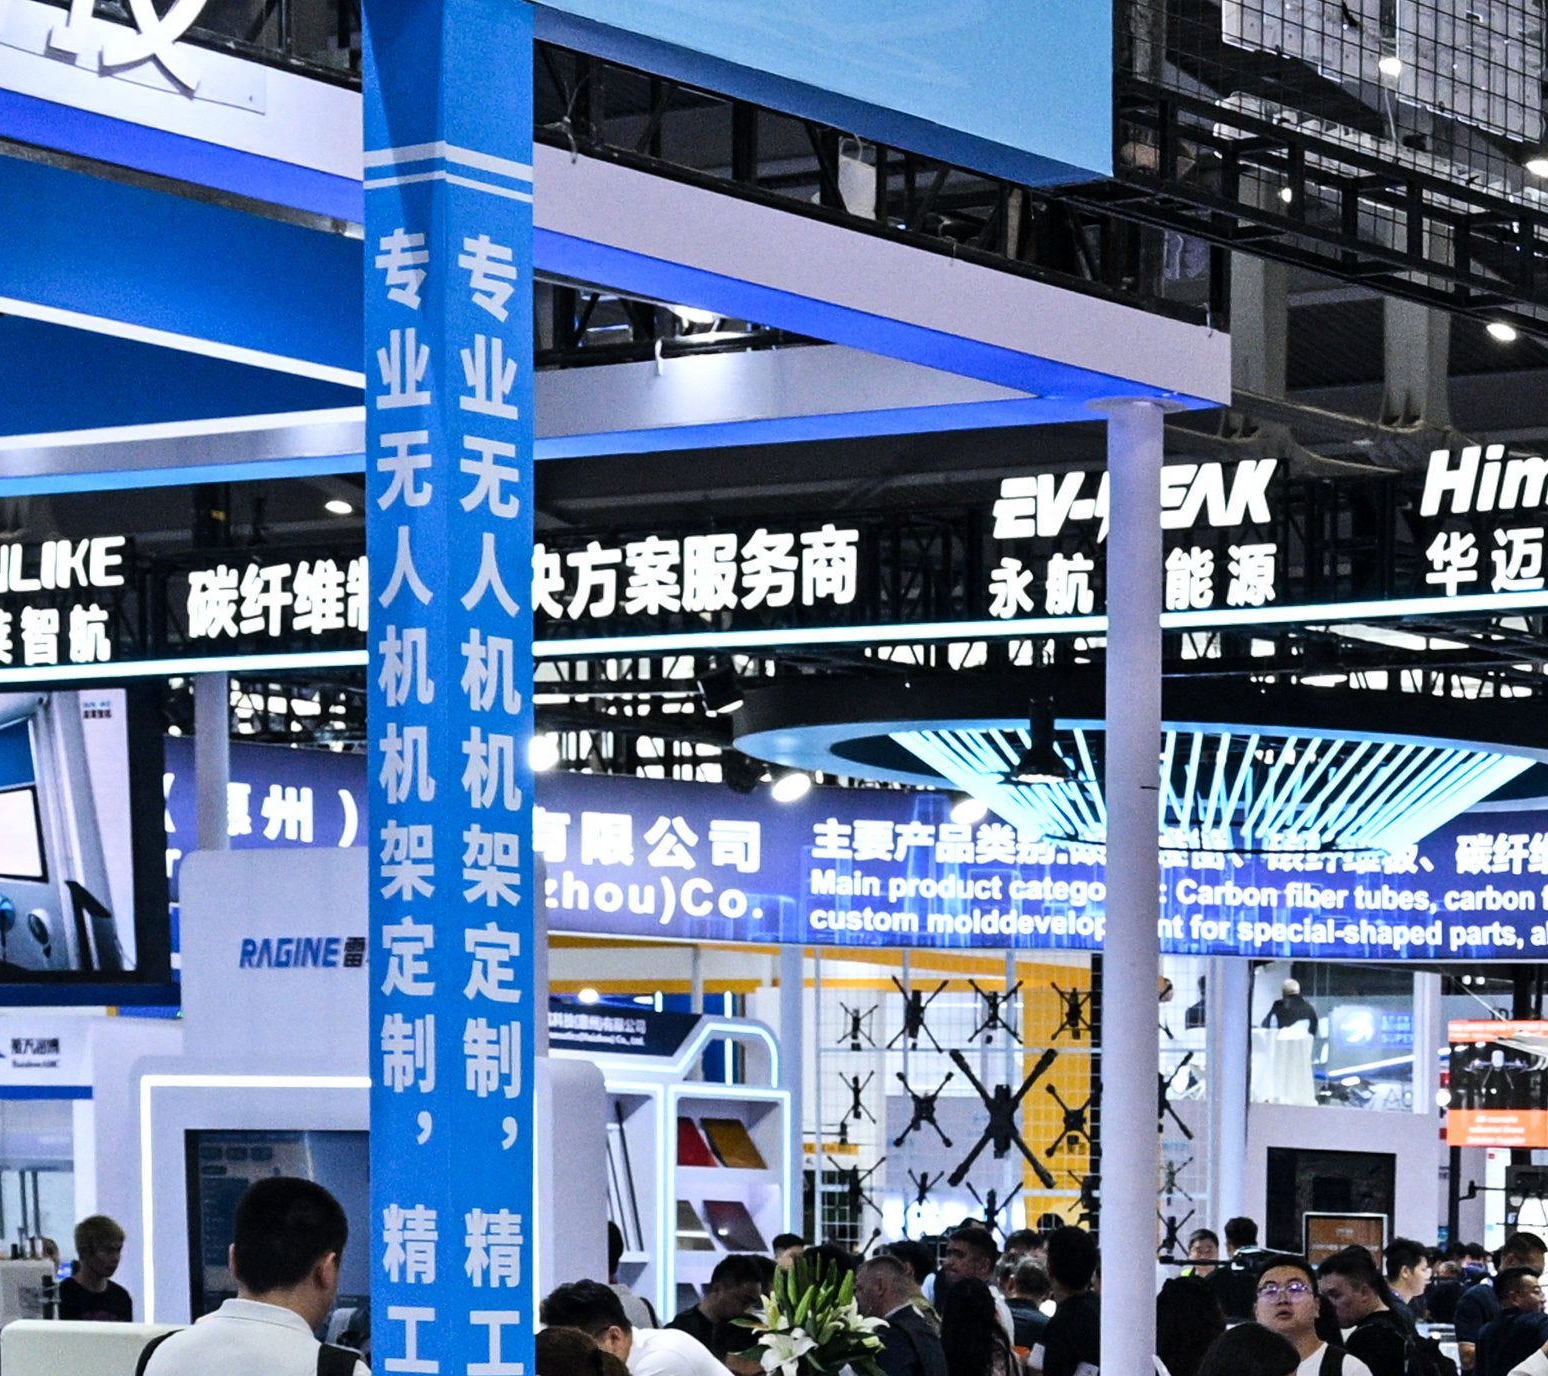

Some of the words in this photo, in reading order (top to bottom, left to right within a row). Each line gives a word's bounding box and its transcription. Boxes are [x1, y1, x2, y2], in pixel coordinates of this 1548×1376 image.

[987, 543, 1278, 620] 永航能源
[544, 866, 764, 924] zhou)Co.
[811, 869, 883, 899] Main
[888, 871, 1003, 903] product
[1175, 879, 1279, 906] Carbon
[1353, 884, 1437, 914] tubes,
[1443, 885, 1535, 912] carbon
[240, 936, 342, 969] RAGINE
[810, 910, 920, 935] custom
[1190, 918, 1231, 942] for
[1237, 919, 1443, 951] special-shaped
[1451, 922, 1524, 950] parts,
